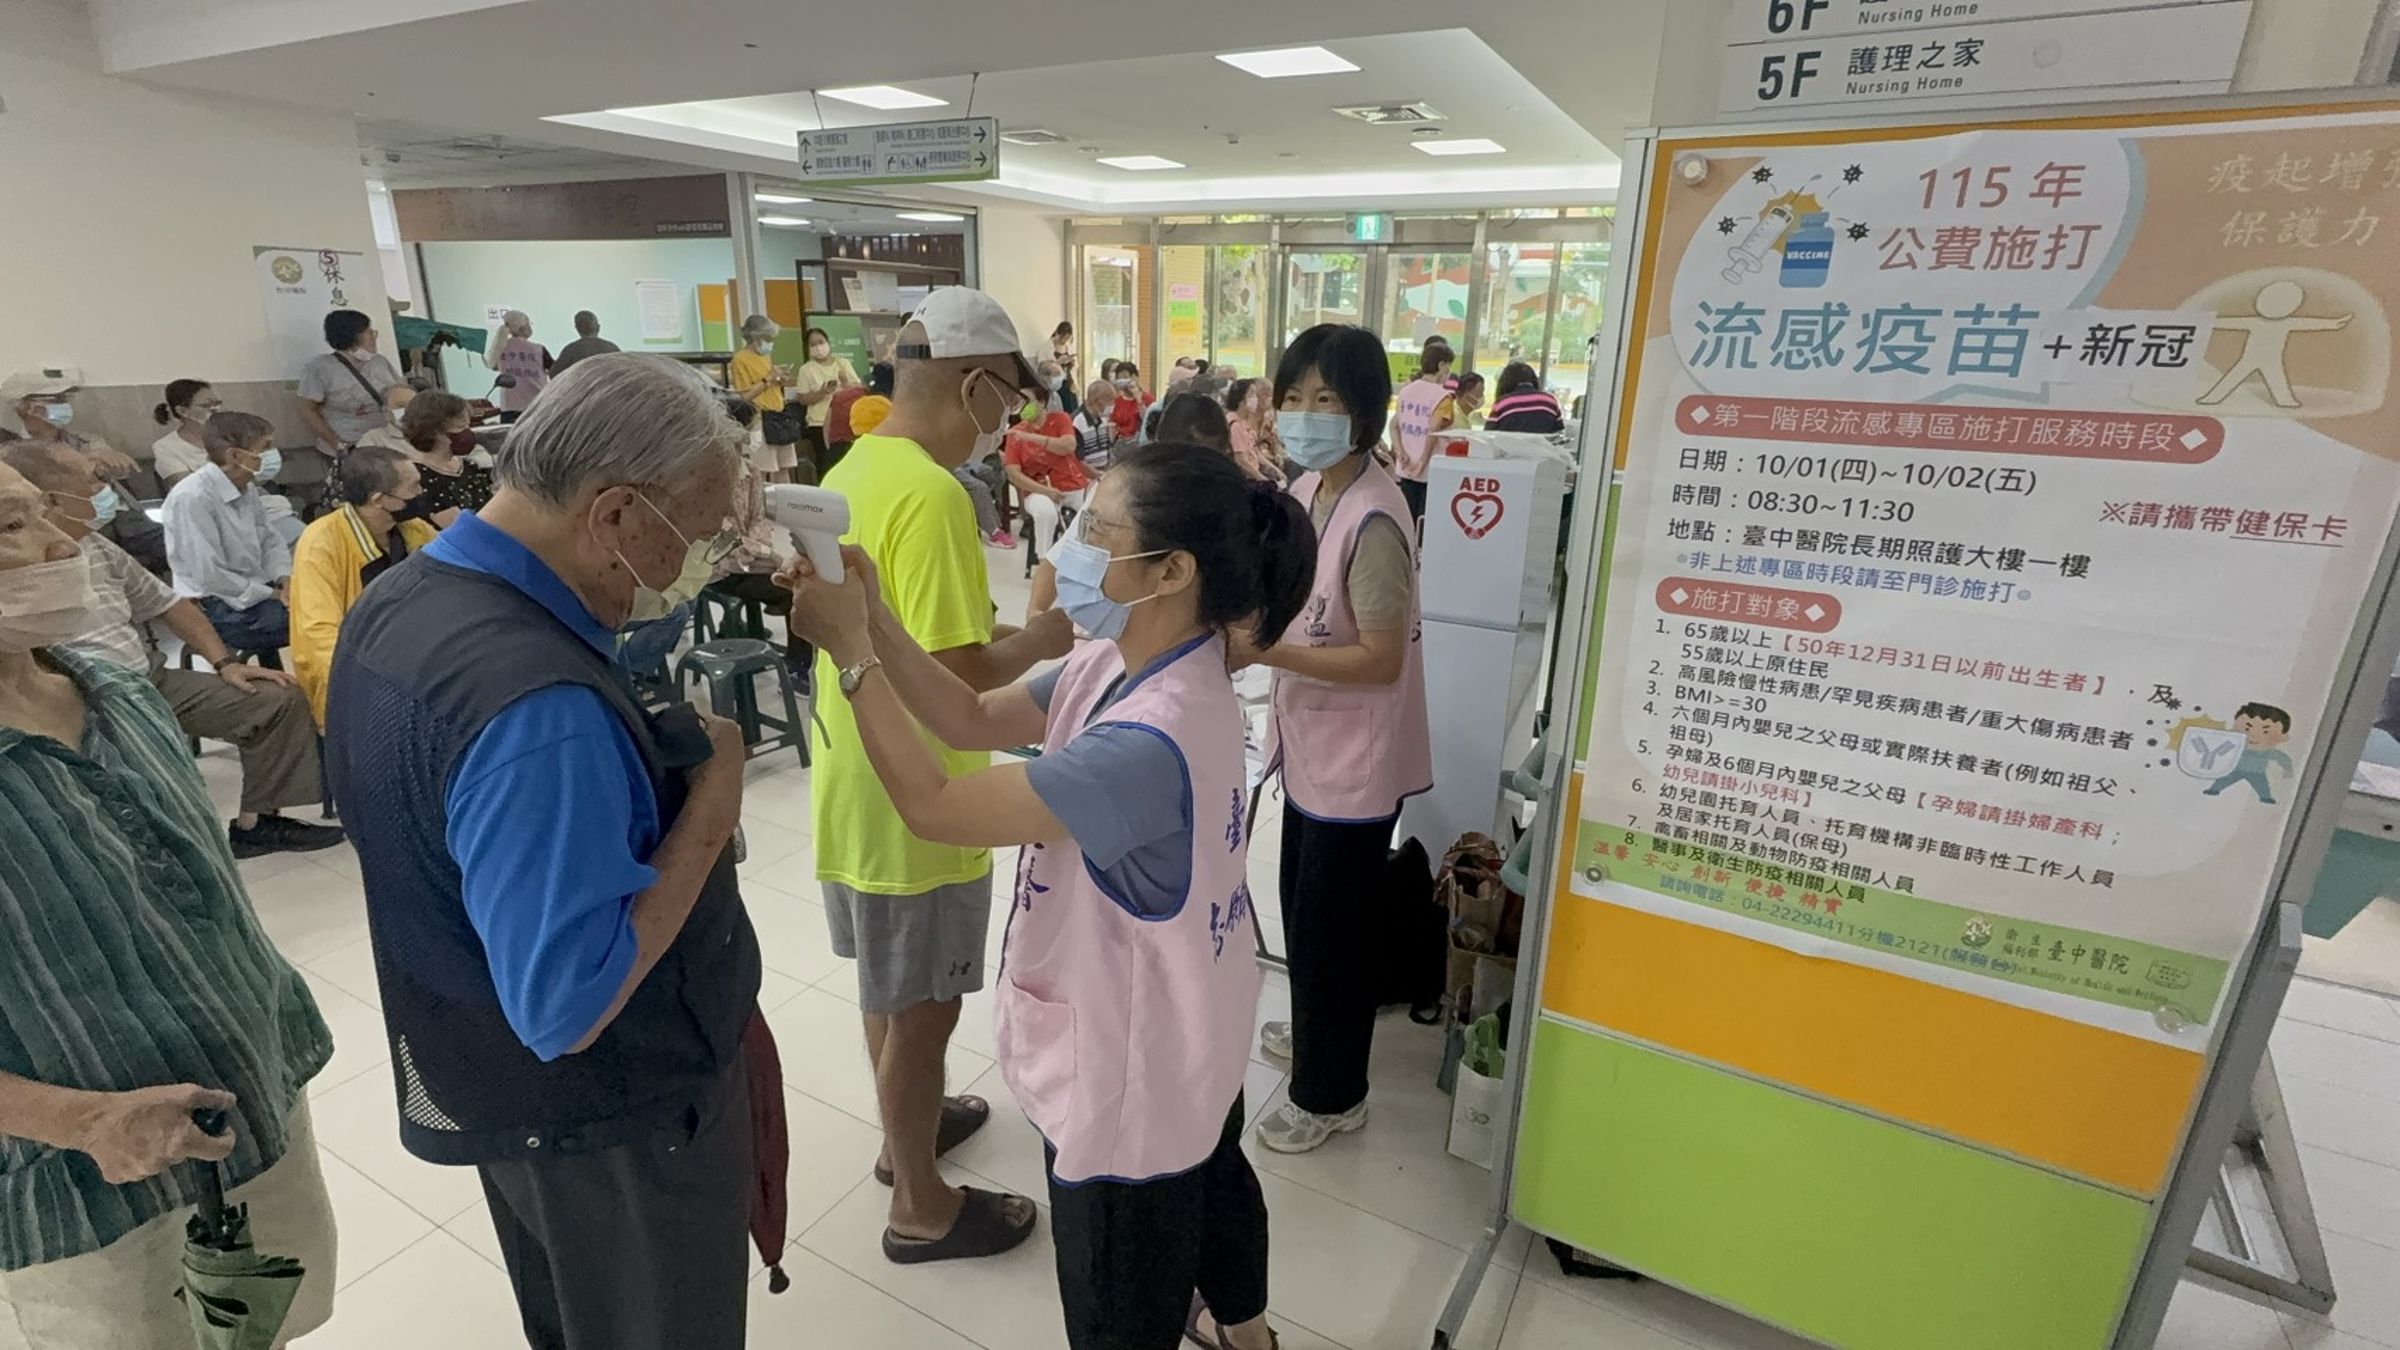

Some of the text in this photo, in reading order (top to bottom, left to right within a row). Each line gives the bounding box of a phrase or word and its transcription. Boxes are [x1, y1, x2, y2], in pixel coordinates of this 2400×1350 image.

[1767, 0, 1829, 33] 6F
[1857, 3, 1979, 25] Nursing Home
[1847, 37, 1985, 76] 護理之家
[1757, 50, 1822, 100] 5F
[1845, 76, 1963, 95] Nursing Home
[2221, 206, 2381, 249] 保護力
[1785, 250, 1830, 260] VACCINE
[1877, 223, 2103, 271] 公費施打
[1688, 300, 2040, 378] 流感疫苗
[1459, 476, 1500, 493] AED
[1691, 587, 1800, 621] 施打對象
[1681, 643, 1829, 679] 55歲以上原住民
[1668, 724, 1714, 748] 祖母)
[1651, 837, 1866, 904] 醫事及衛生防疫相關人員
[1653, 821, 1915, 895] 禽畜相關及動物防疫相關人員
[2048, 939, 2131, 975] 臺中醫院
